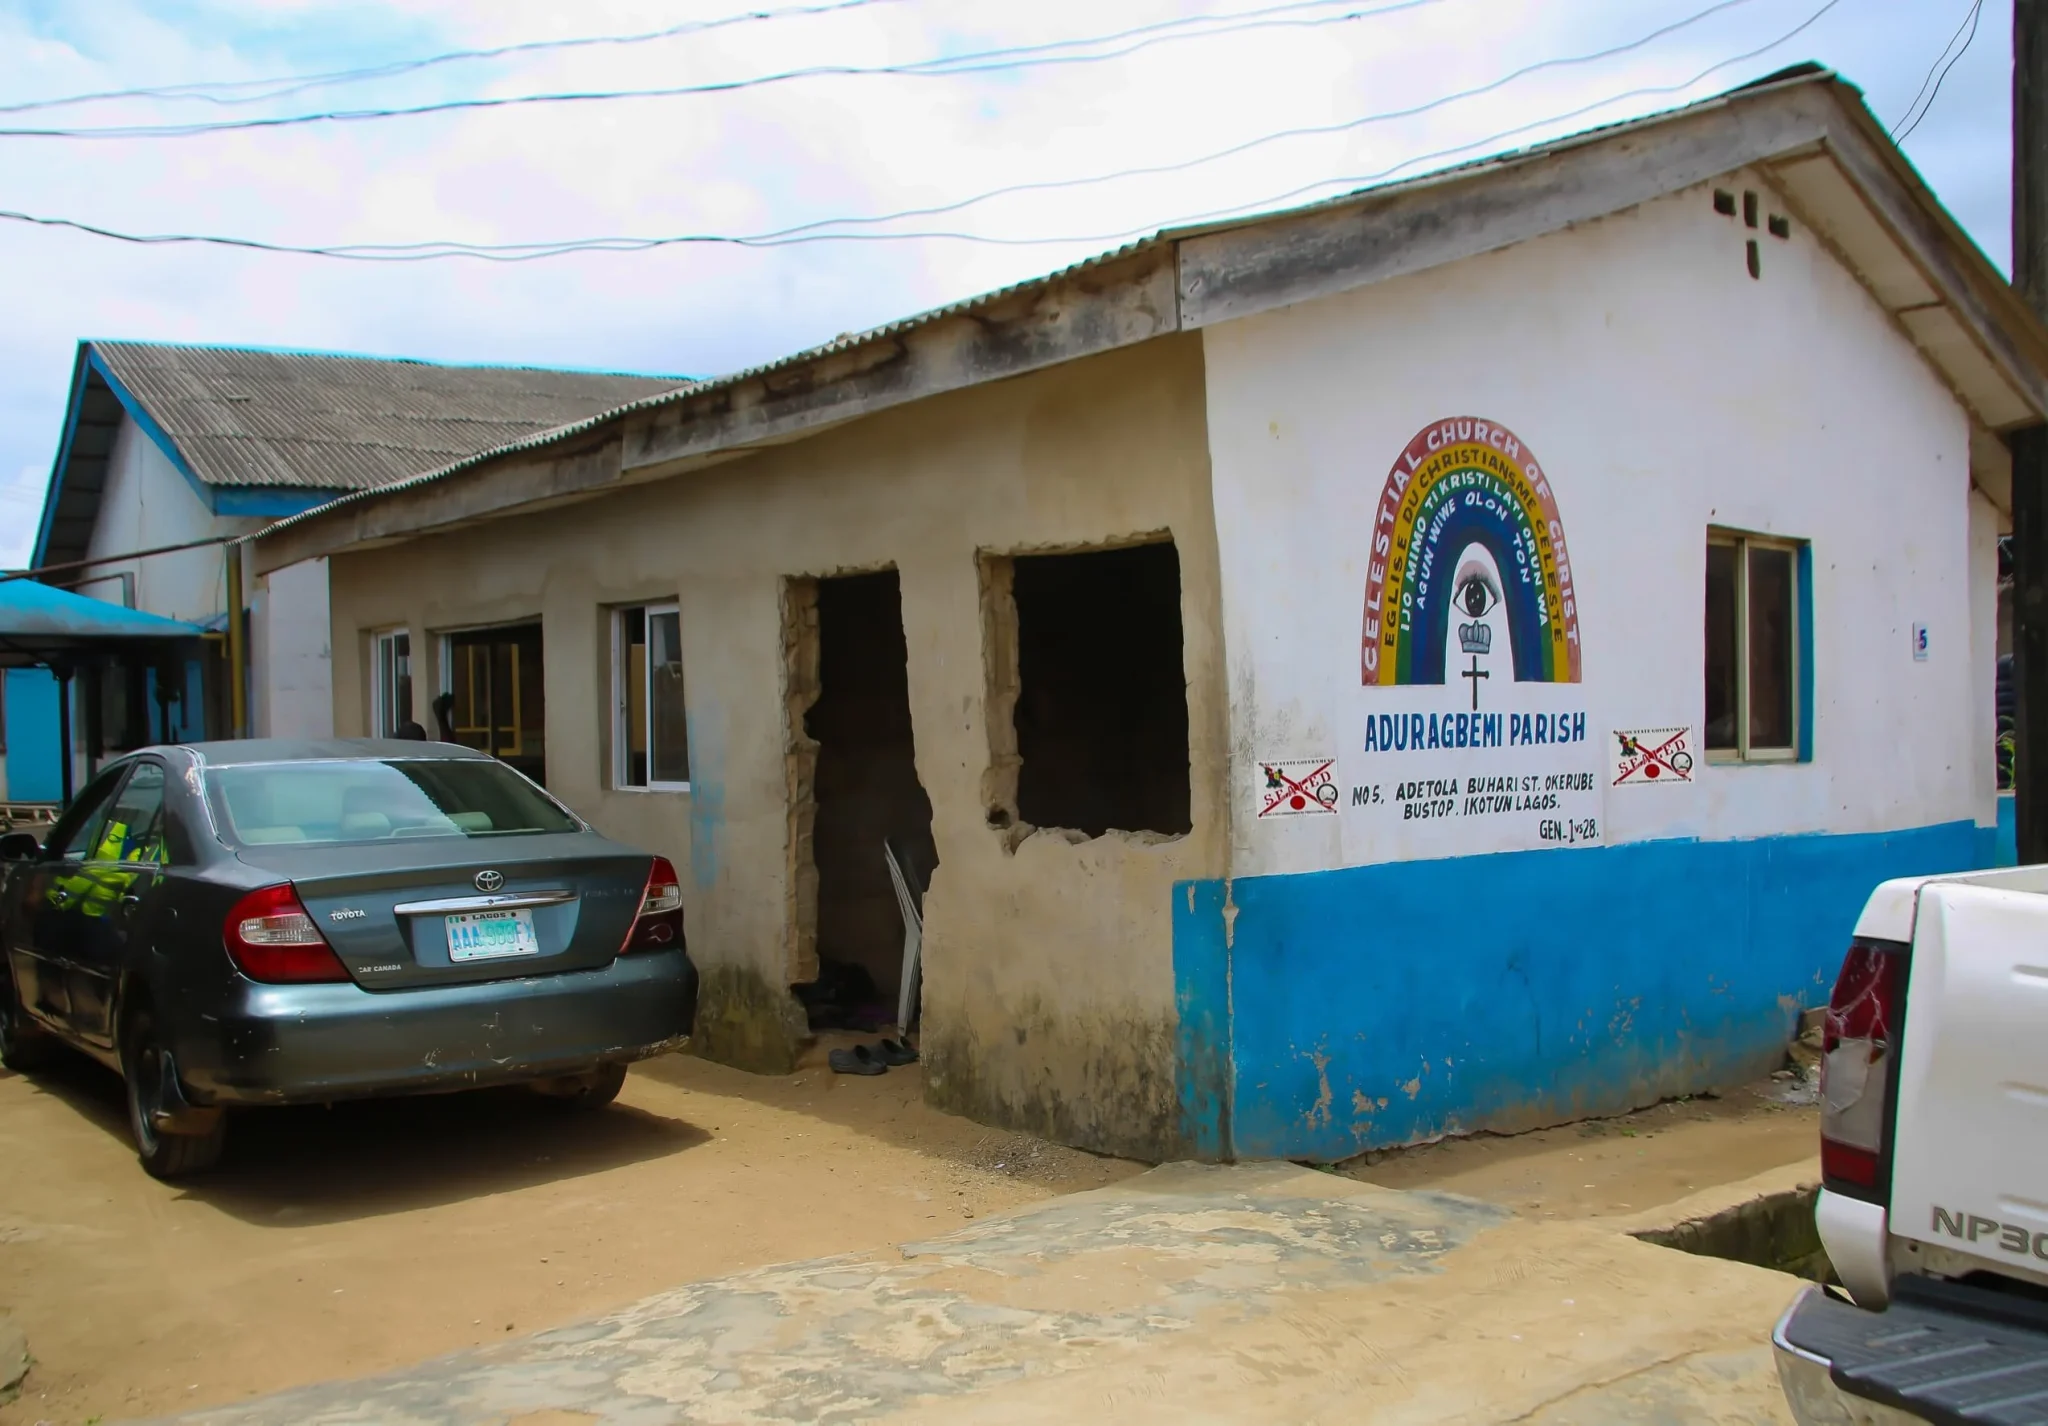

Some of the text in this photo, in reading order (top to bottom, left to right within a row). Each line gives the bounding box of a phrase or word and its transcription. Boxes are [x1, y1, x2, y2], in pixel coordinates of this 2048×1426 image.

[1364, 421, 1580, 669] CELESTIAL CHURCH OF CHRIST
[1384, 448, 1563, 647] EGLISE DU CHRISTIANSME CELESTE
[1400, 471, 1549, 632] IJO MIMO TI KRISTI LATI ORUN WA
[1417, 491, 1531, 609] AGUN WIWE OLON TON
[1918, 628, 1928, 650] 5
[1364, 712, 1586, 752] ADURAGBEMI PARISH
[1618, 738, 1686, 775] SEALED
[1264, 770, 1332, 806] SEALED
[1395, 778, 1459, 801] ADETOLA
[1467, 777, 1518, 795] BUHARI
[1522, 775, 1541, 792] ST.
[1545, 772, 1594, 792] OKERUBE
[1464, 795, 1512, 816] IKOTUN
[1515, 794, 1561, 811] LAGOS.
[330, 909, 366, 921] TOYOTA
[472, 912, 507, 921] LAGOS
[373, 964, 402, 972] CANADA
